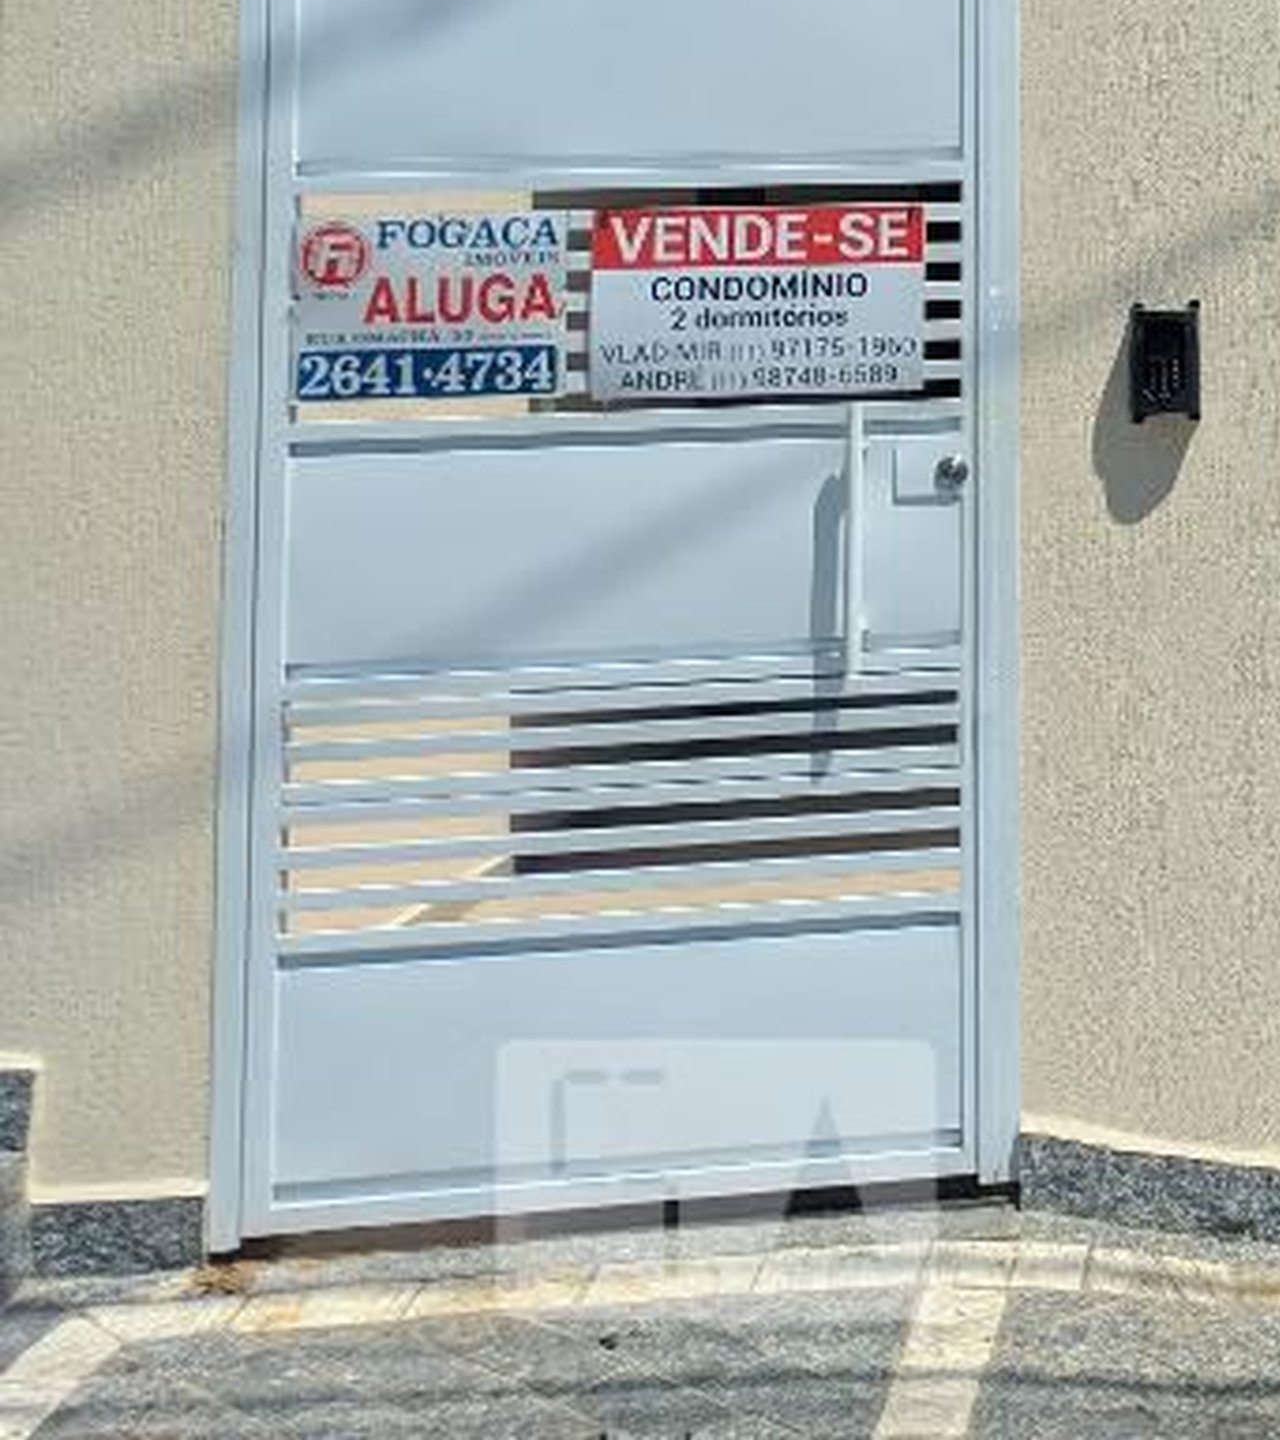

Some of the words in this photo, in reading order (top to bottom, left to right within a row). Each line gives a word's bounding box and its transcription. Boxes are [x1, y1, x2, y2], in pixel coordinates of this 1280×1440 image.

[609, 211, 910, 262] VENDE-SE
[362, 272, 557, 324] ALUGA
[650, 269, 869, 302] CONDOMÍNIO
[670, 308, 688, 332] 2
[694, 303, 849, 330] dormitórios
